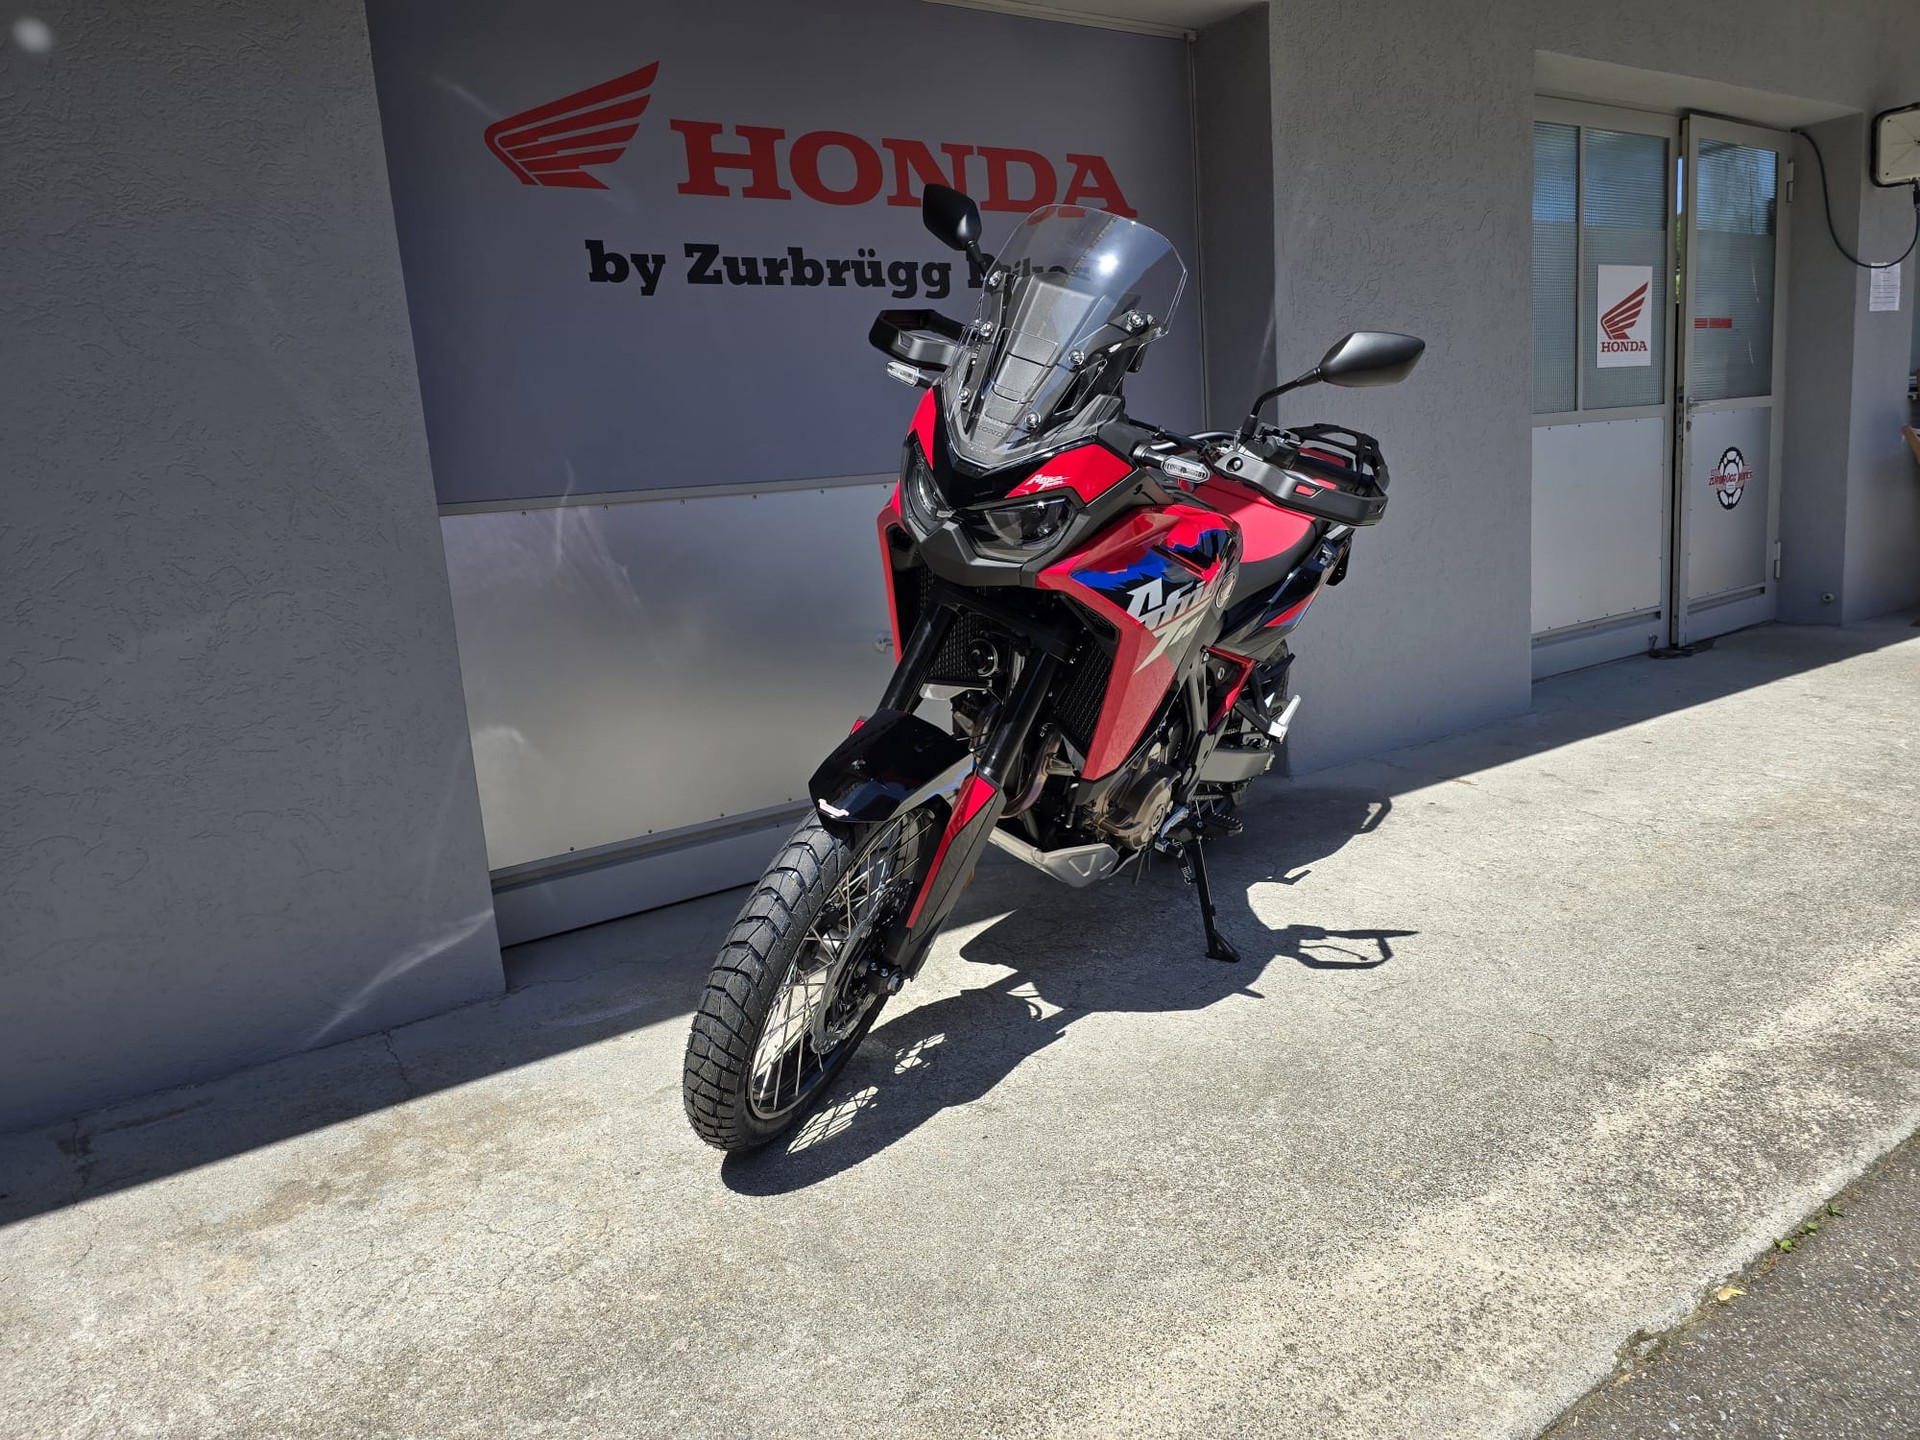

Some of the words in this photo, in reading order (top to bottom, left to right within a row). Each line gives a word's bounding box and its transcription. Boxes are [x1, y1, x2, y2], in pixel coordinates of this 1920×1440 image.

[669, 119, 1137, 218] HONDA
[585, 240, 666, 296] by
[684, 243, 951, 299] Zurbrügg
[1600, 340, 1648, 352] HONDA
